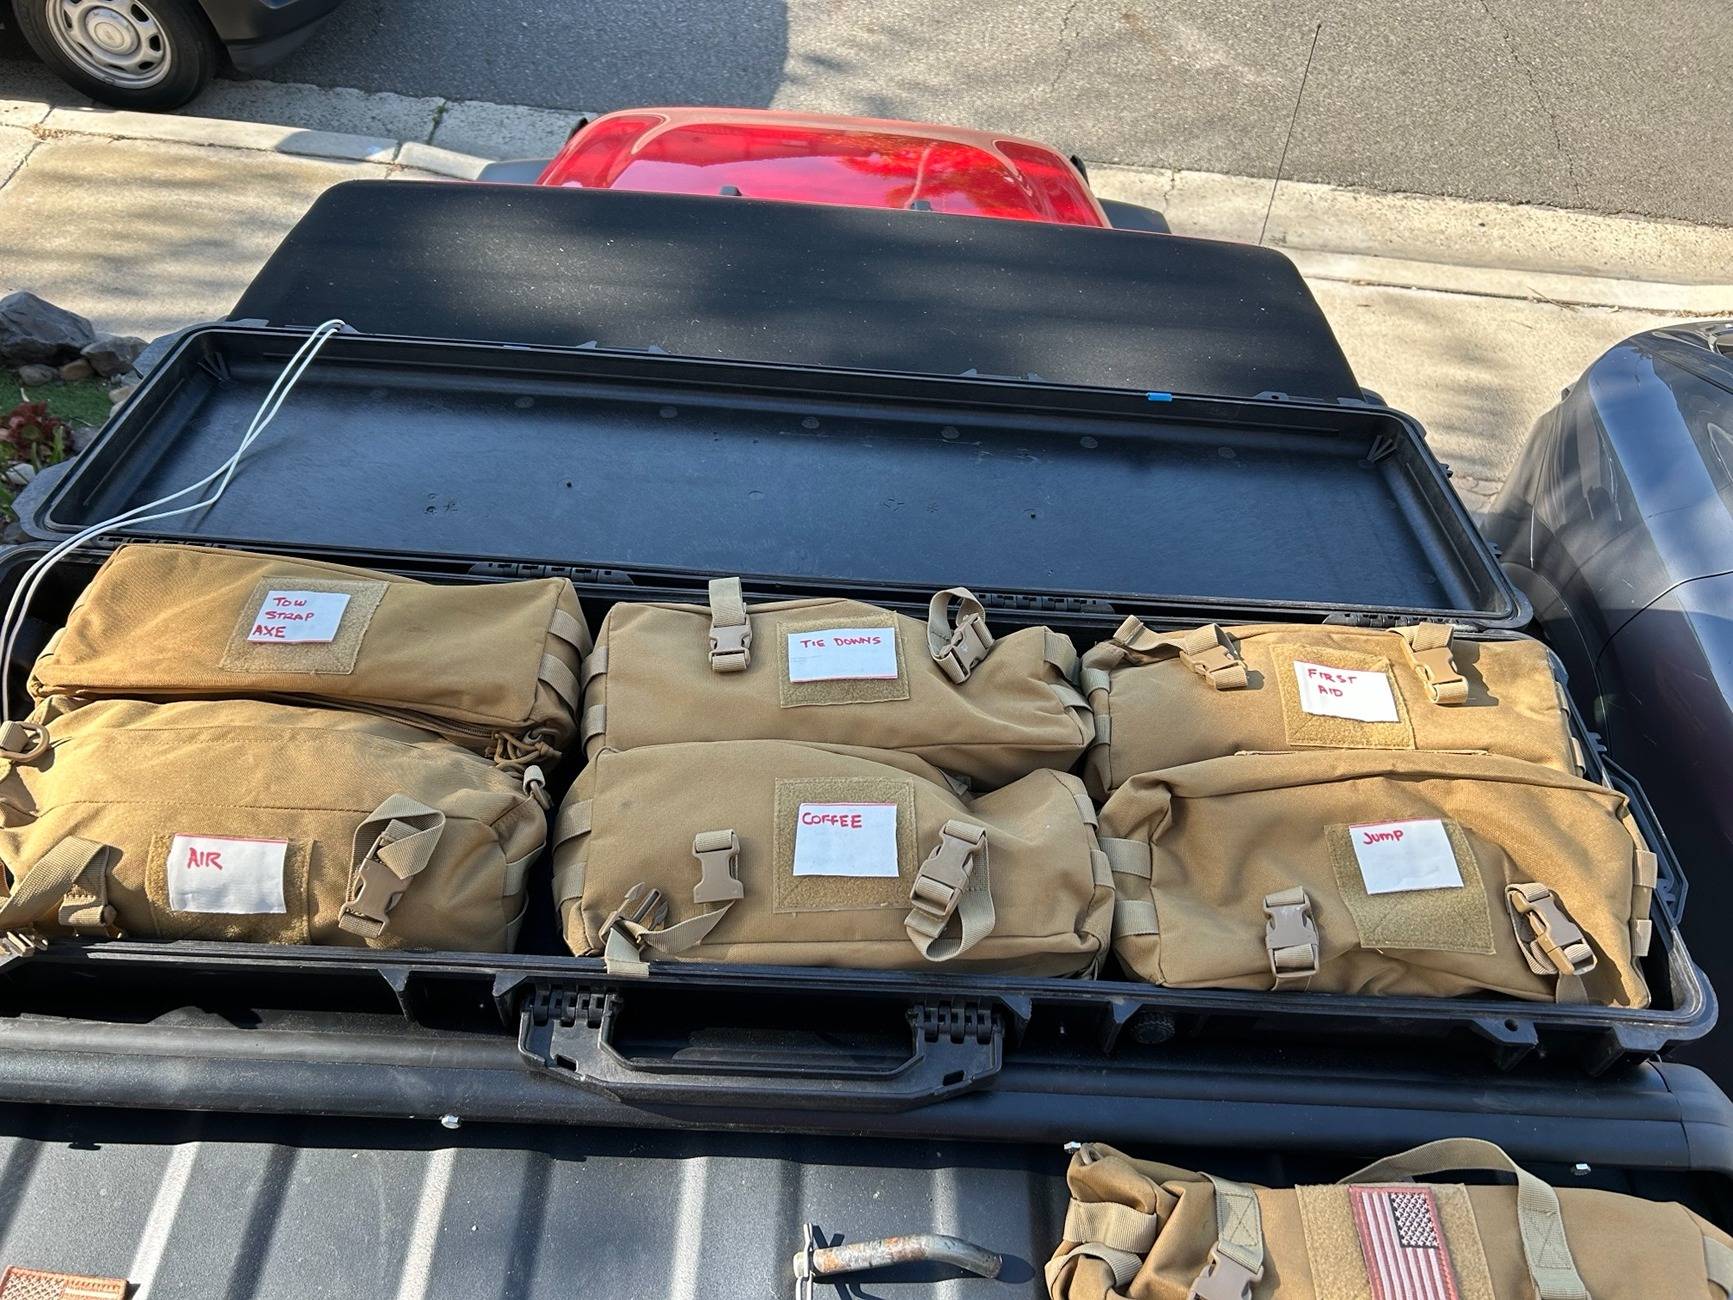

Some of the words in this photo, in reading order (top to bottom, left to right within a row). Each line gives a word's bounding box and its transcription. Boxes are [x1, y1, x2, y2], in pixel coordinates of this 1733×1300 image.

[273, 596, 308, 607] TOW
[264, 610, 315, 621] STRAP
[252, 624, 287, 638] AXE
[832, 636, 882, 647] DOWNS
[1307, 668, 1358, 684] FIRST
[1317, 684, 1344, 698] AID
[801, 812, 863, 829] COFFEE
[186, 847, 223, 870] AIR
